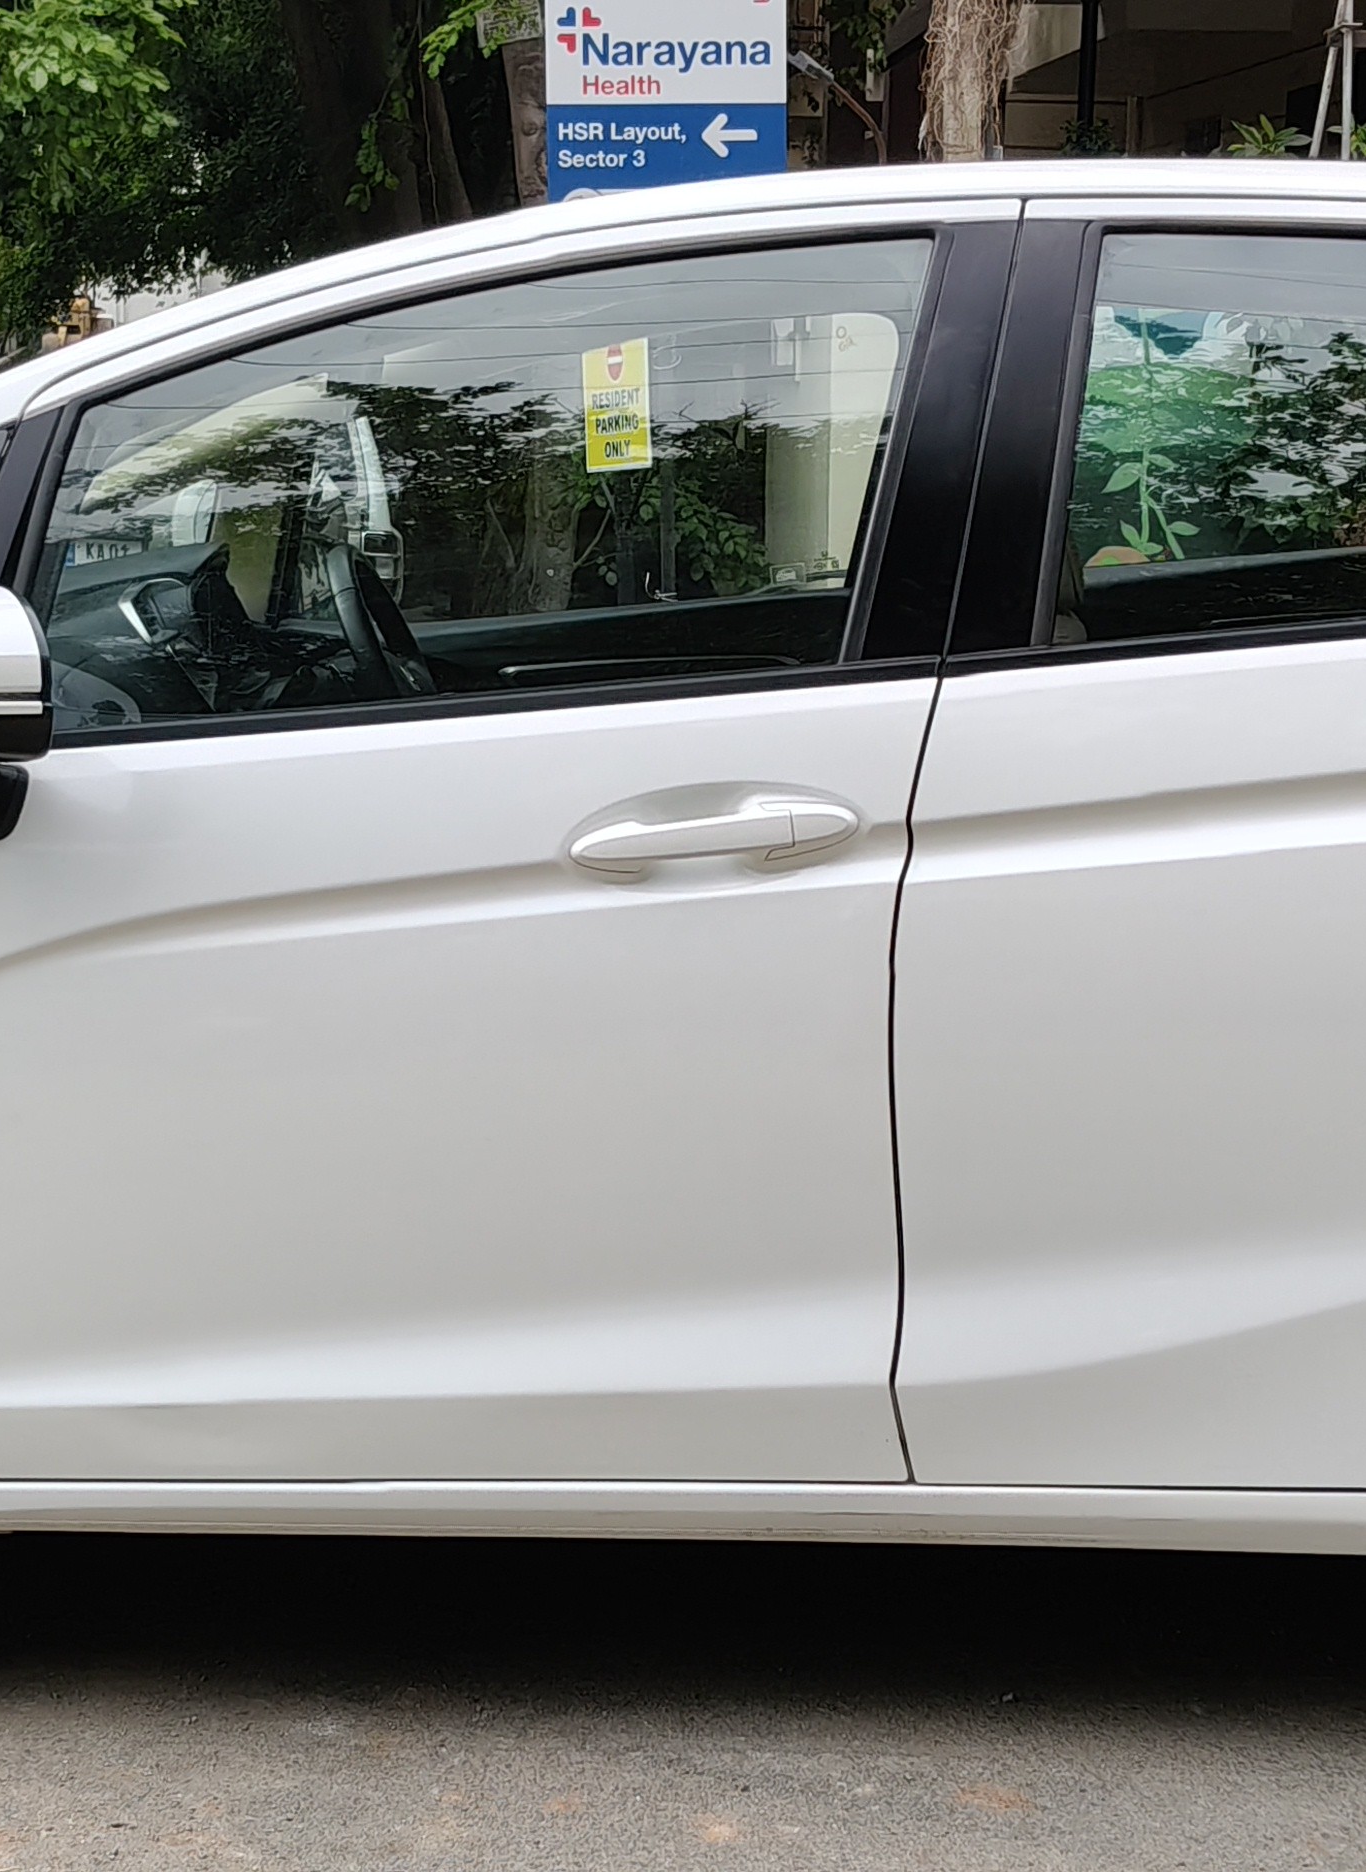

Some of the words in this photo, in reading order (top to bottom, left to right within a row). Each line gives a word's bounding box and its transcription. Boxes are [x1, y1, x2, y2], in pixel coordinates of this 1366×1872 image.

[582, 33, 771, 73] Narayana
[582, 75, 661, 96] Health
[557, 122, 604, 141] HSR
[610, 122, 686, 145] Layout,
[557, 149, 628, 168] Sector
[632, 149, 646, 167] 3
[591, 388, 641, 410] RESIDENT
[595, 413, 640, 434] PARKING
[604, 439, 631, 459] ONLY
